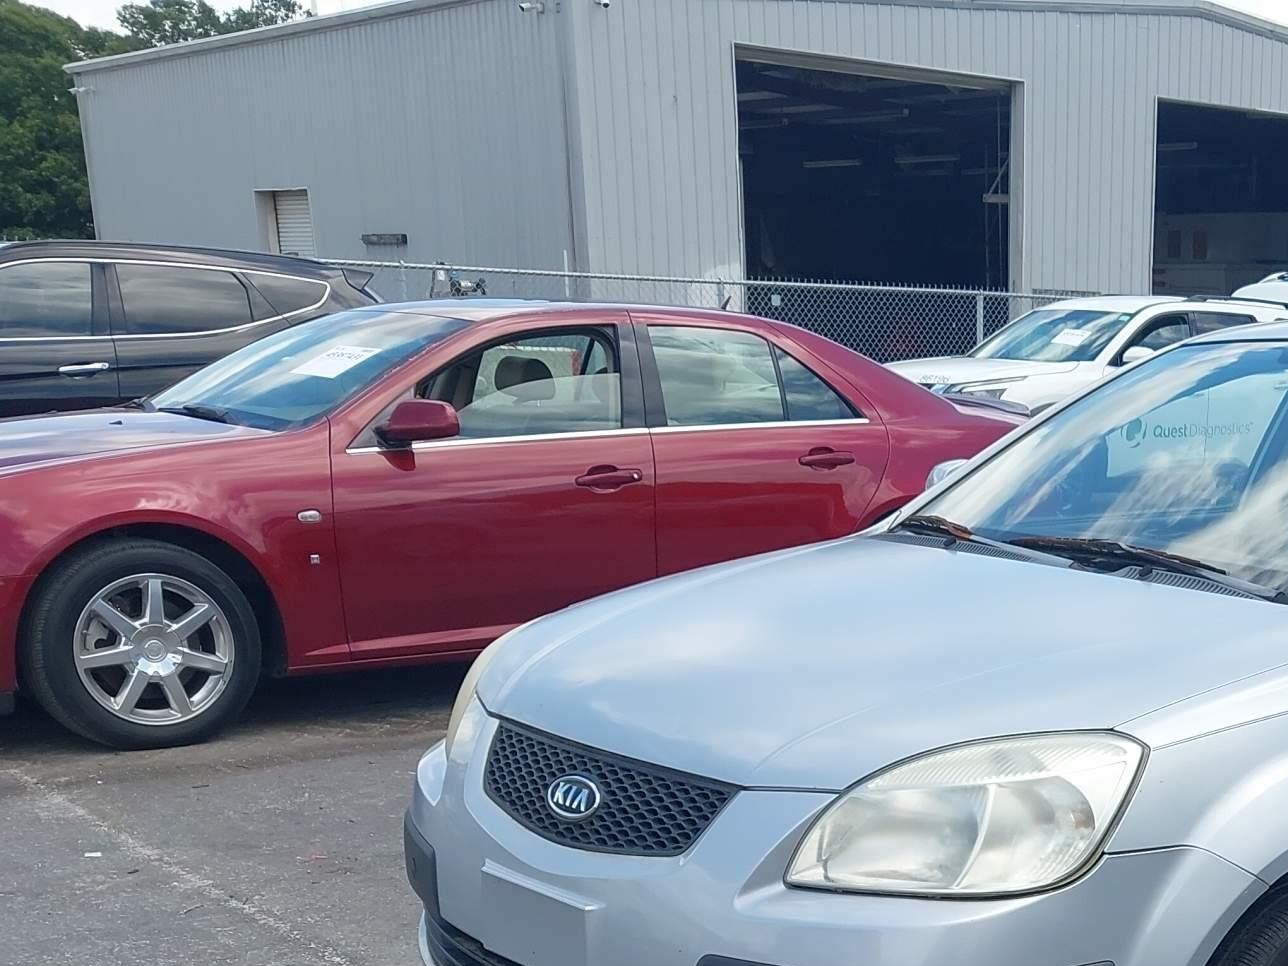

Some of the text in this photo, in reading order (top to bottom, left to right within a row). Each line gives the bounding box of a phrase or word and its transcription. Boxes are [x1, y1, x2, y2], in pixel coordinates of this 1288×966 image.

[1153, 422, 1251, 439] Quest Diagnostics
[553, 781, 589, 812] KIA
